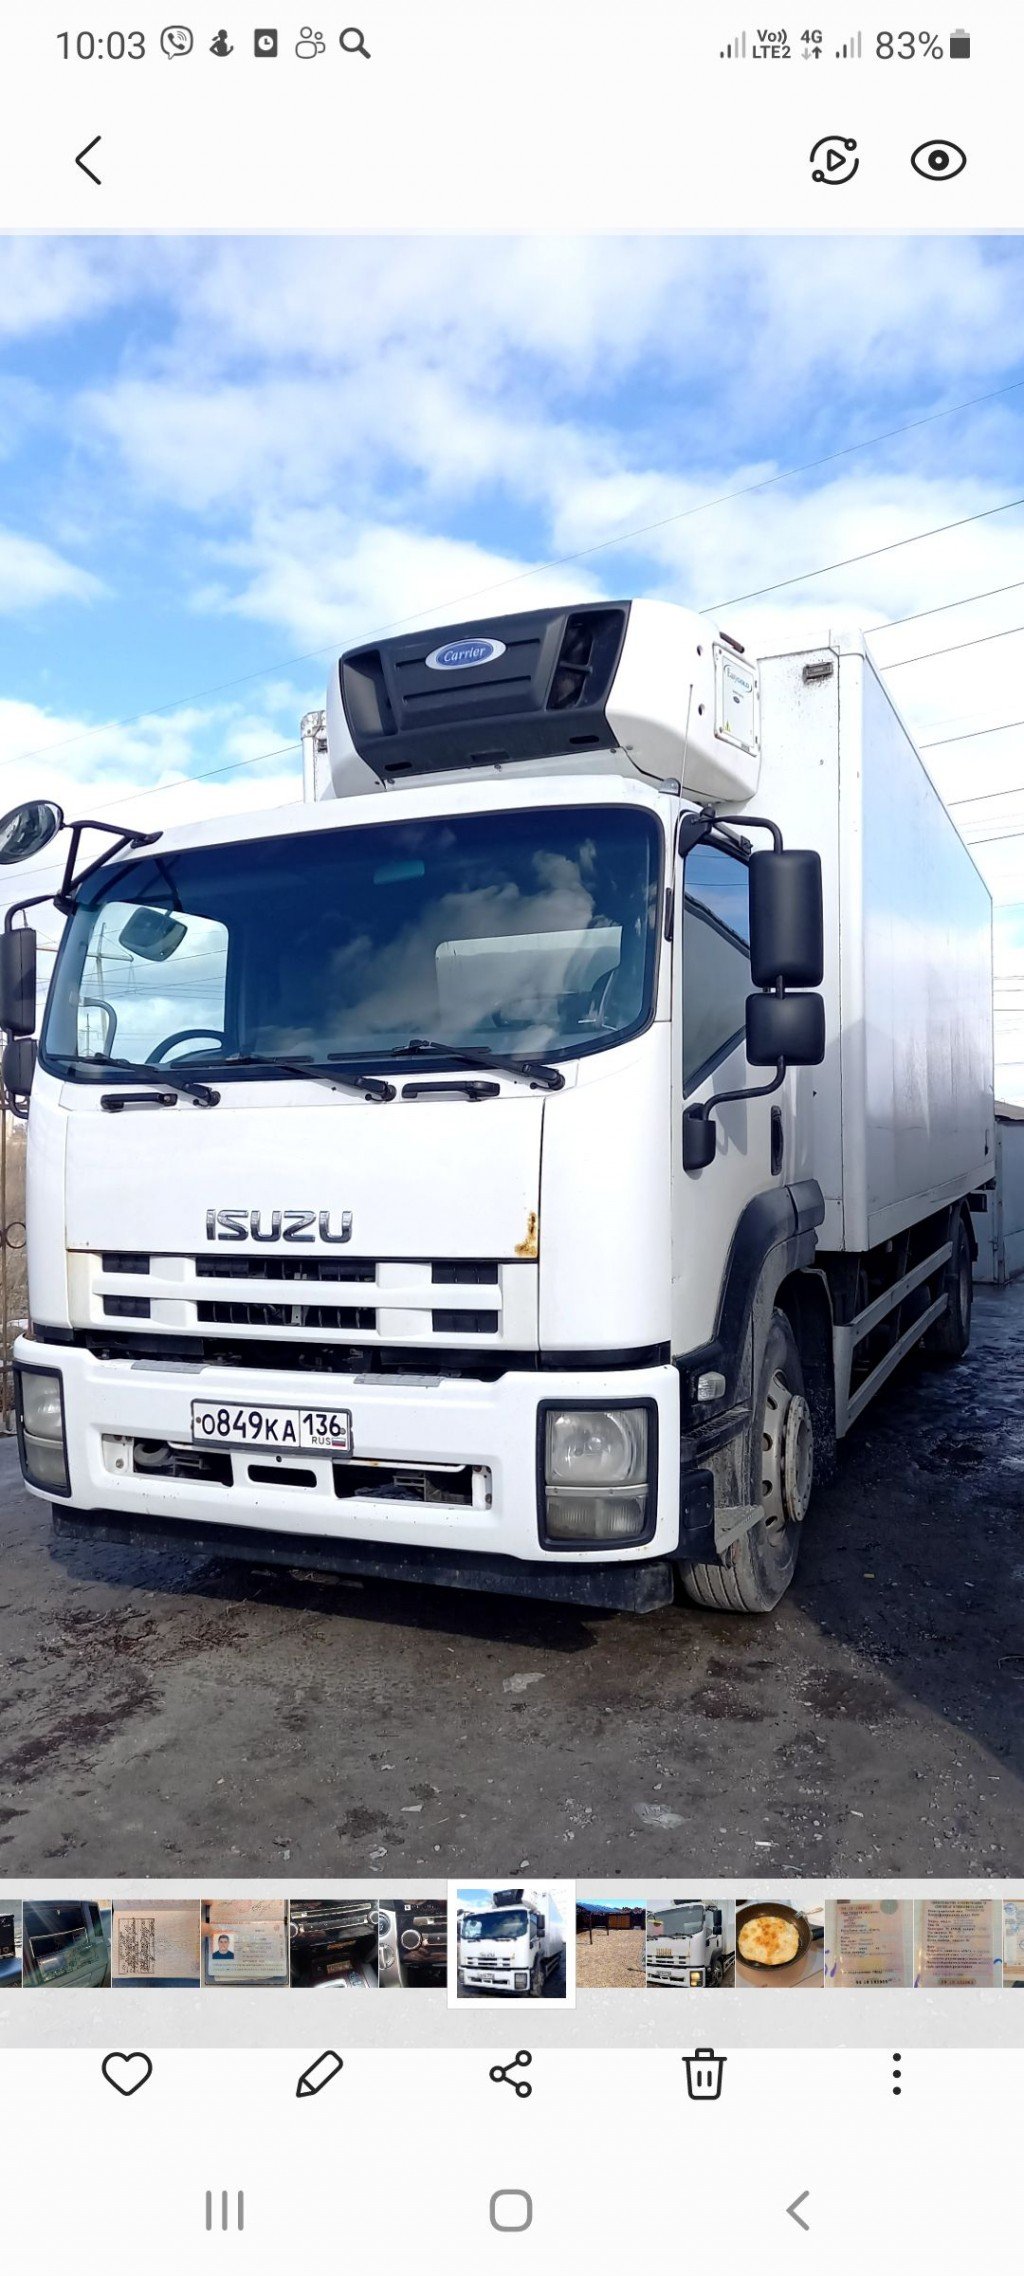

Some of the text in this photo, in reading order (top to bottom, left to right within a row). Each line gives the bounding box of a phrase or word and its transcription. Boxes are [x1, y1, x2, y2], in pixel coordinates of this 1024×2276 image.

[57, 31, 145, 59] 10:03
[800, 30, 823, 44] 4G
[876, 31, 944, 59] 83%
[752, 45, 791, 59] LTE2
[443, 647, 486, 662] Carrier
[206, 1209, 353, 1243] ISUZU
[303, 1413, 341, 1436] 136
[311, 1436, 331, 1446] RUS
